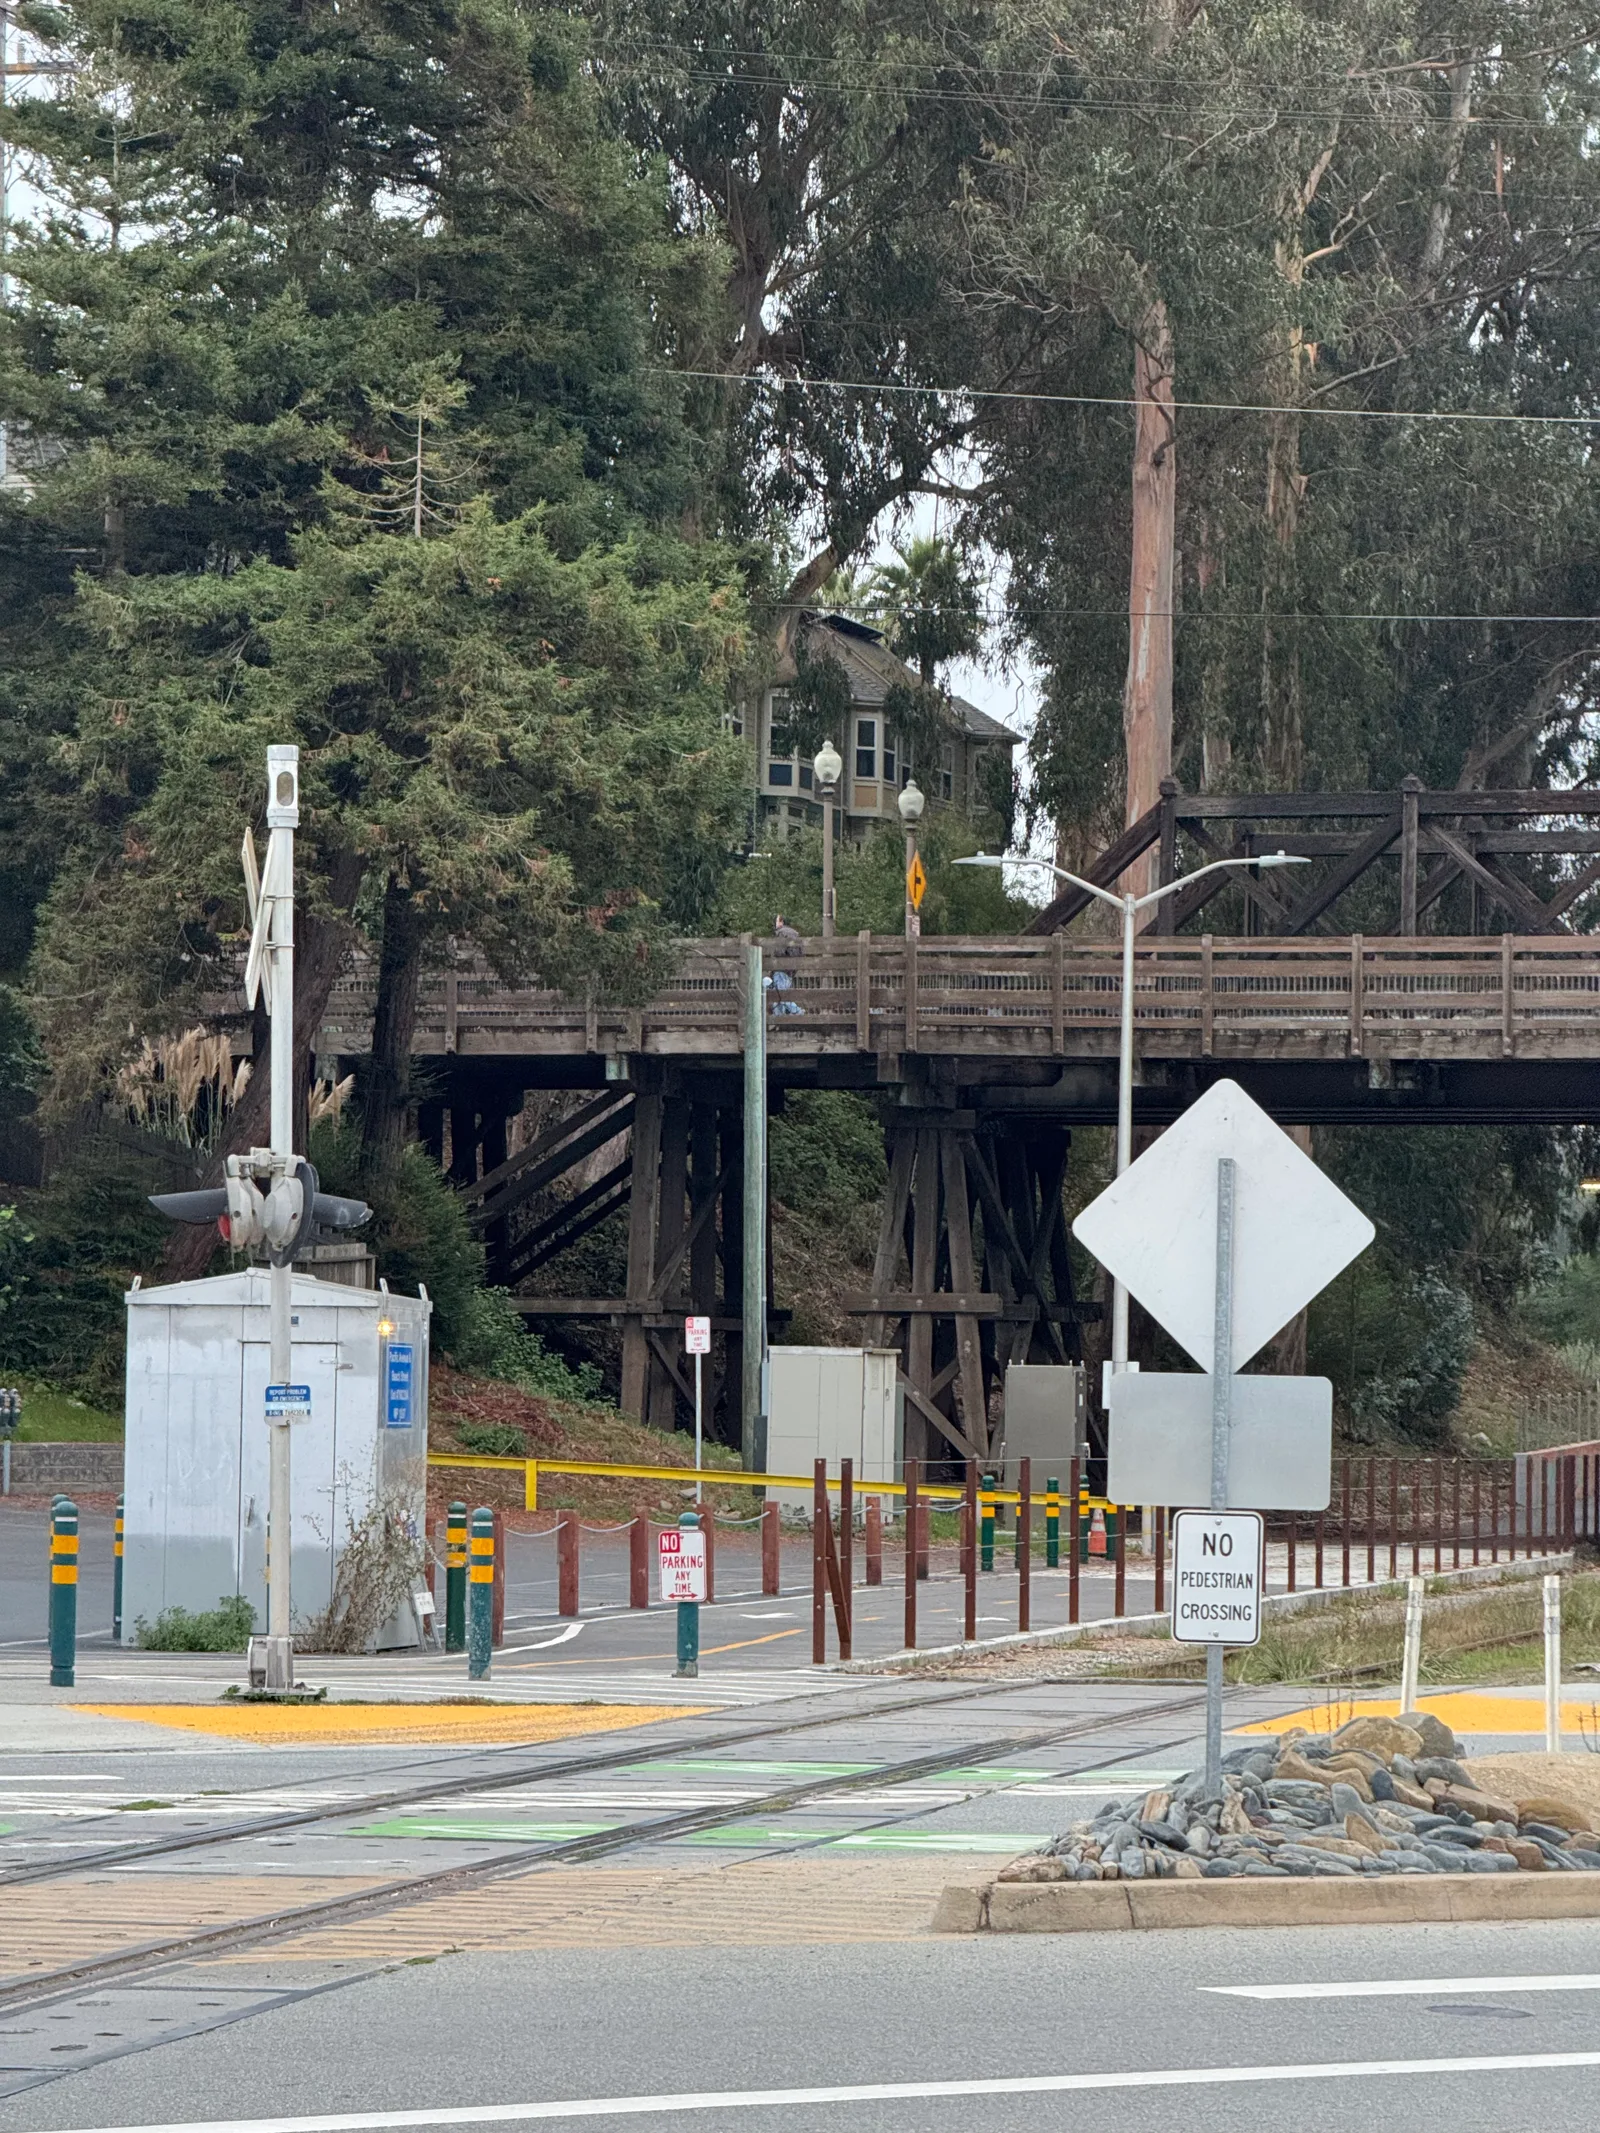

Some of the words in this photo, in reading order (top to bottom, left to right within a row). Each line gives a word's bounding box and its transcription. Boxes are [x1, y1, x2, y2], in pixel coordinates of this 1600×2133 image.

[661, 1534, 678, 1551] NO
[1202, 1533, 1233, 1557] NO
[662, 1555, 703, 1569] PARKING
[674, 1570, 691, 1581] ANY
[1180, 1571, 1253, 1589] PEDESTRIAN
[674, 1582, 691, 1593] TIME
[1180, 1603, 1253, 1621] CROSSING
